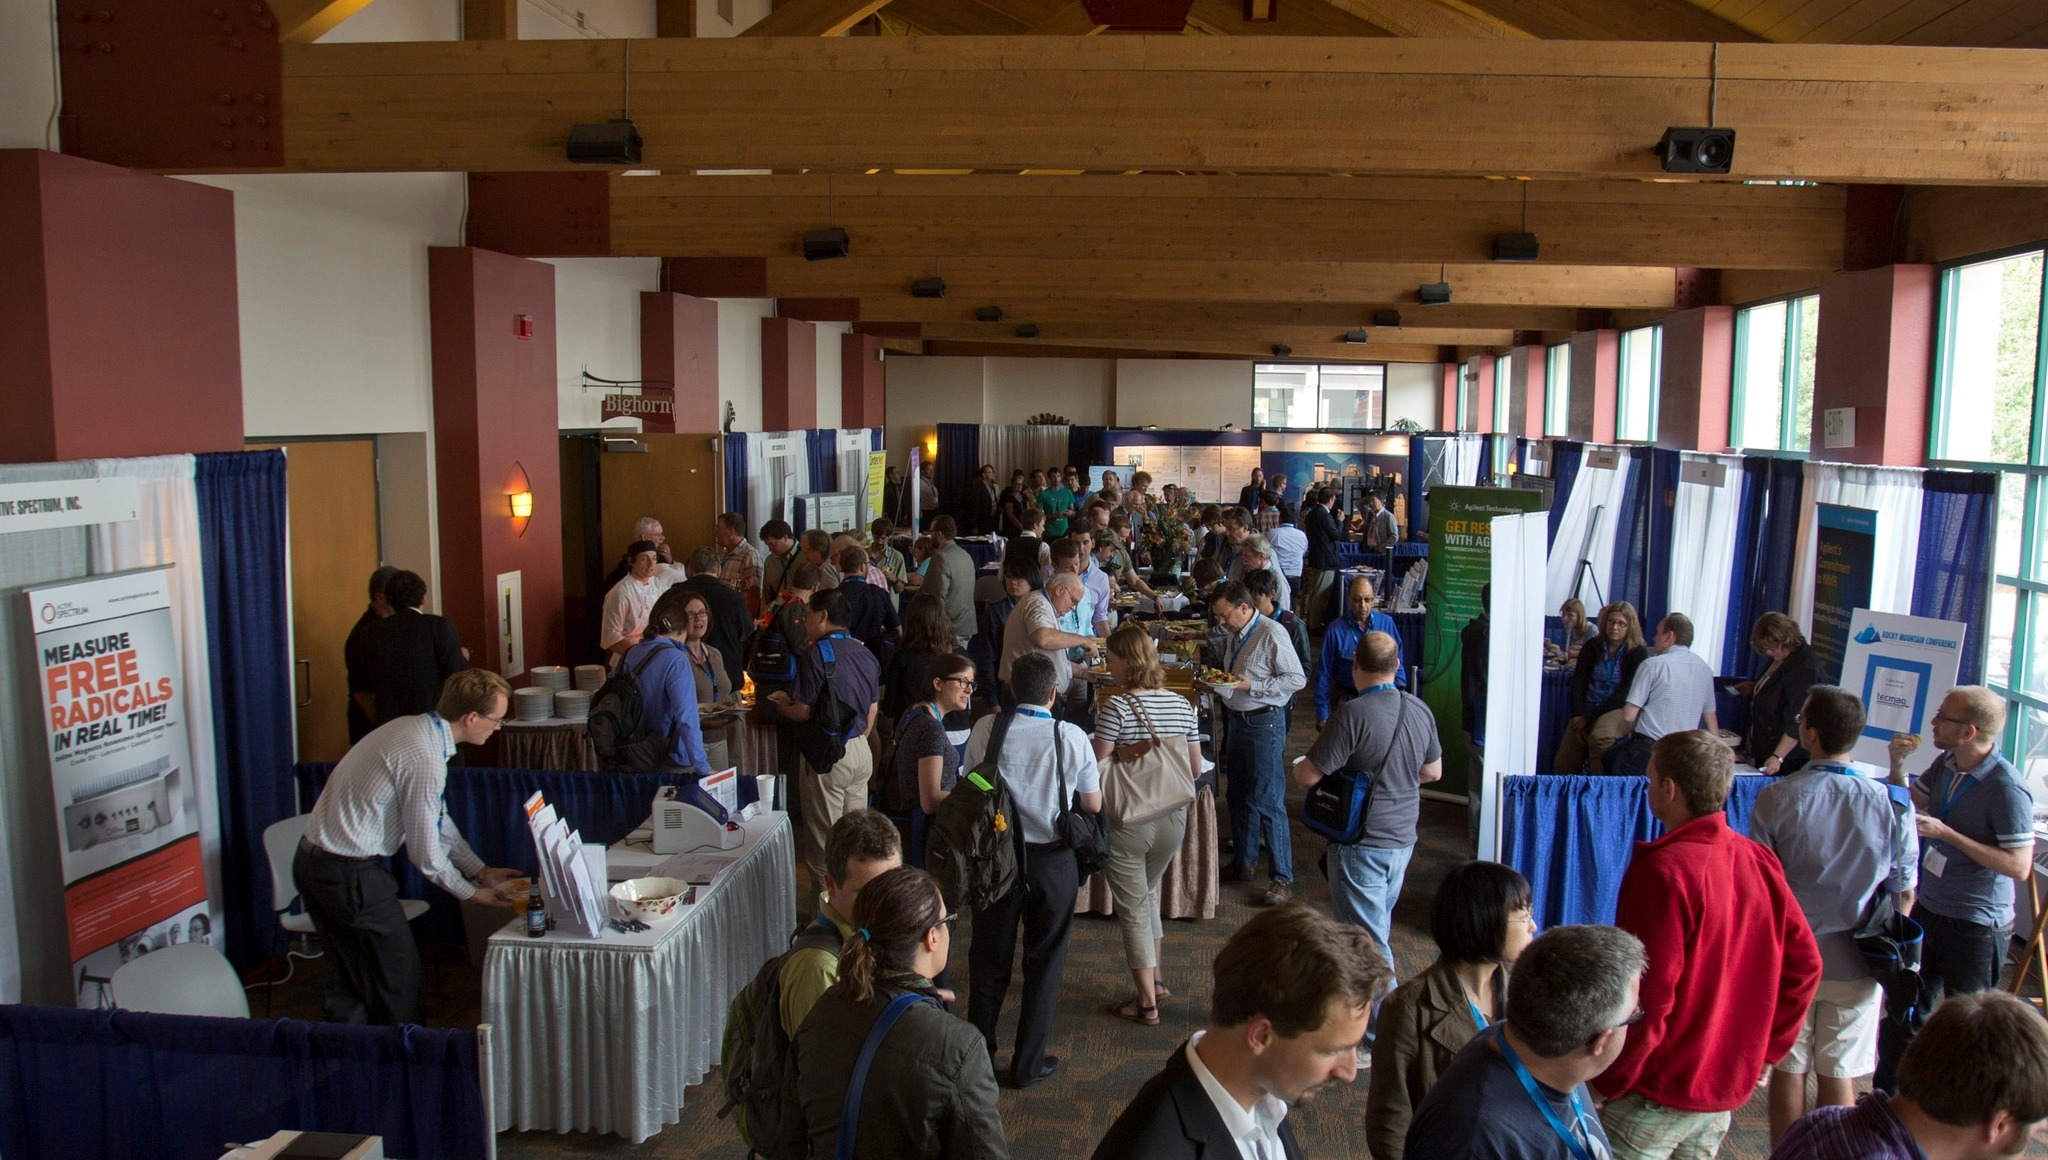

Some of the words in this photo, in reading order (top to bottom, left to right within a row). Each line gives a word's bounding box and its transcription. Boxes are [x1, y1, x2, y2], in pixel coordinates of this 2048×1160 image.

[606, 394, 671, 415] Bighorn
[17, 498, 64, 514] SPECTRUM,
[66, 496, 82, 511] INC.
[1464, 503, 1485, 512] Agilent
[1486, 504, 1523, 514] Technologies
[1445, 520, 1468, 534] GET
[1445, 533, 1473, 546] WITH
[57, 606, 89, 619] SPECTRUM
[1882, 630, 1899, 640] ROCKY
[1899, 632, 1925, 644] MOUNTAIN
[1925, 637, 1957, 649] CONFERENCE
[44, 632, 130, 667] MEASURE
[46, 649, 140, 705] FREE
[50, 677, 173, 733] RADICALS
[54, 730, 72, 753] IN
[75, 717, 122, 746] REAL
[127, 703, 167, 731] TIME!
